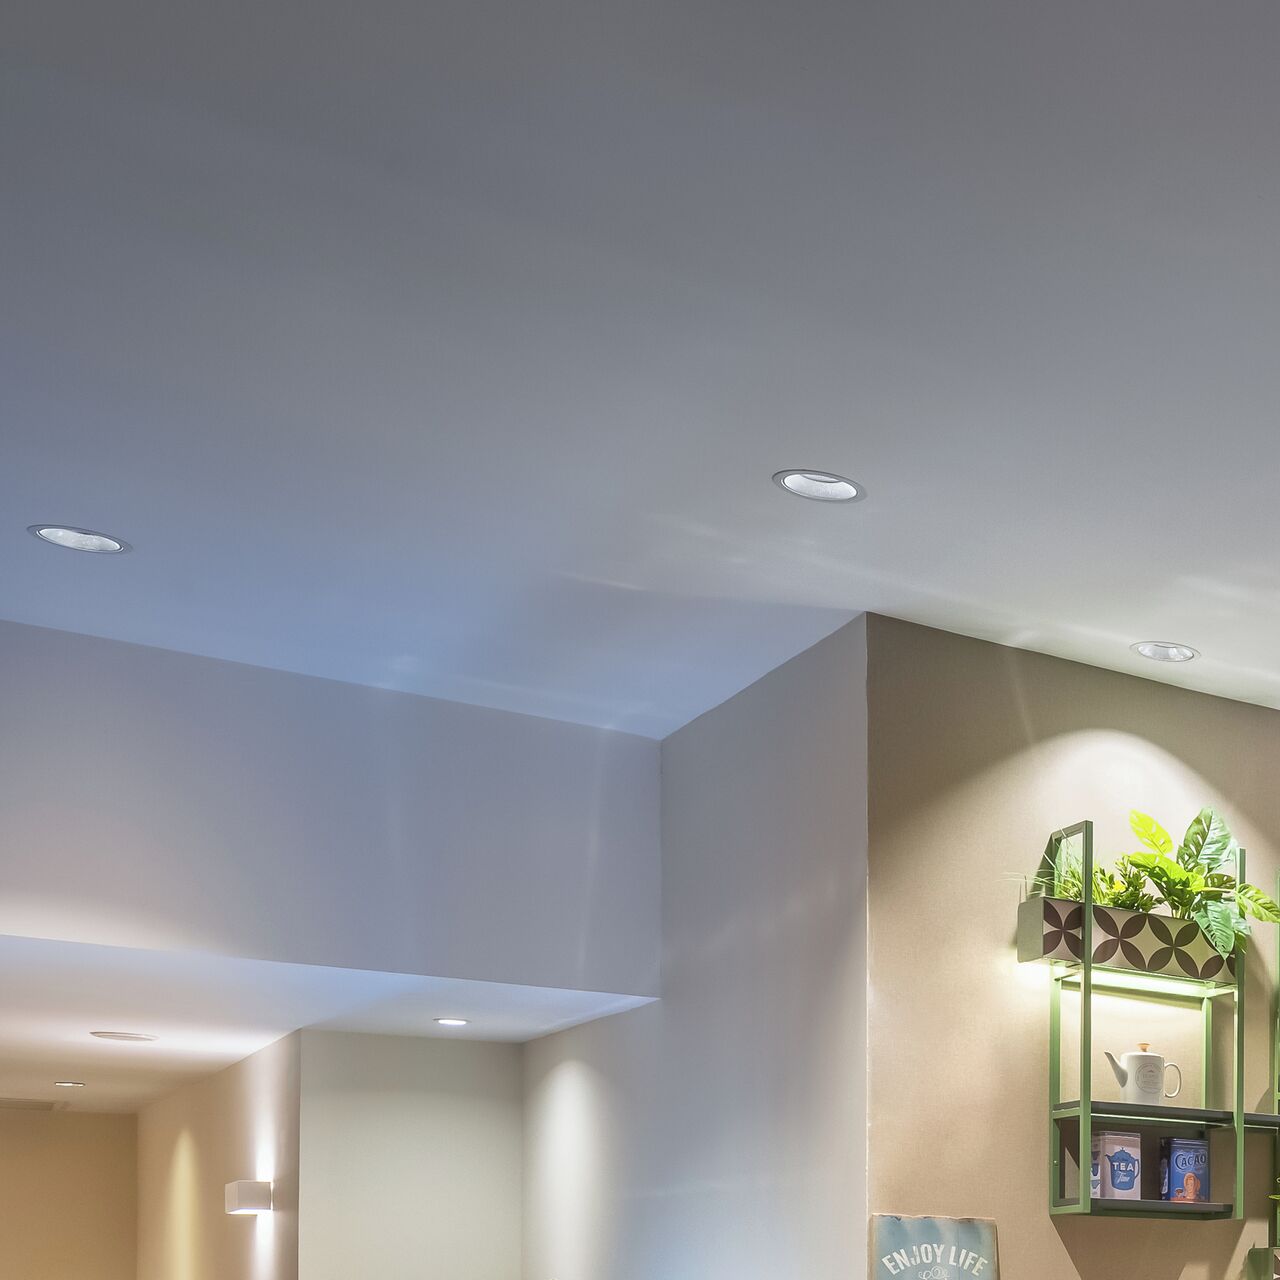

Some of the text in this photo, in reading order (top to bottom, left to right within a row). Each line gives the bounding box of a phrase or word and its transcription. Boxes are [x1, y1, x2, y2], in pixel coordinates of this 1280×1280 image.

[1112, 1162, 1134, 1171] TEA
[1175, 1153, 1206, 1171] CACAO
[882, 1243, 988, 1276] ENJOY LIFE
